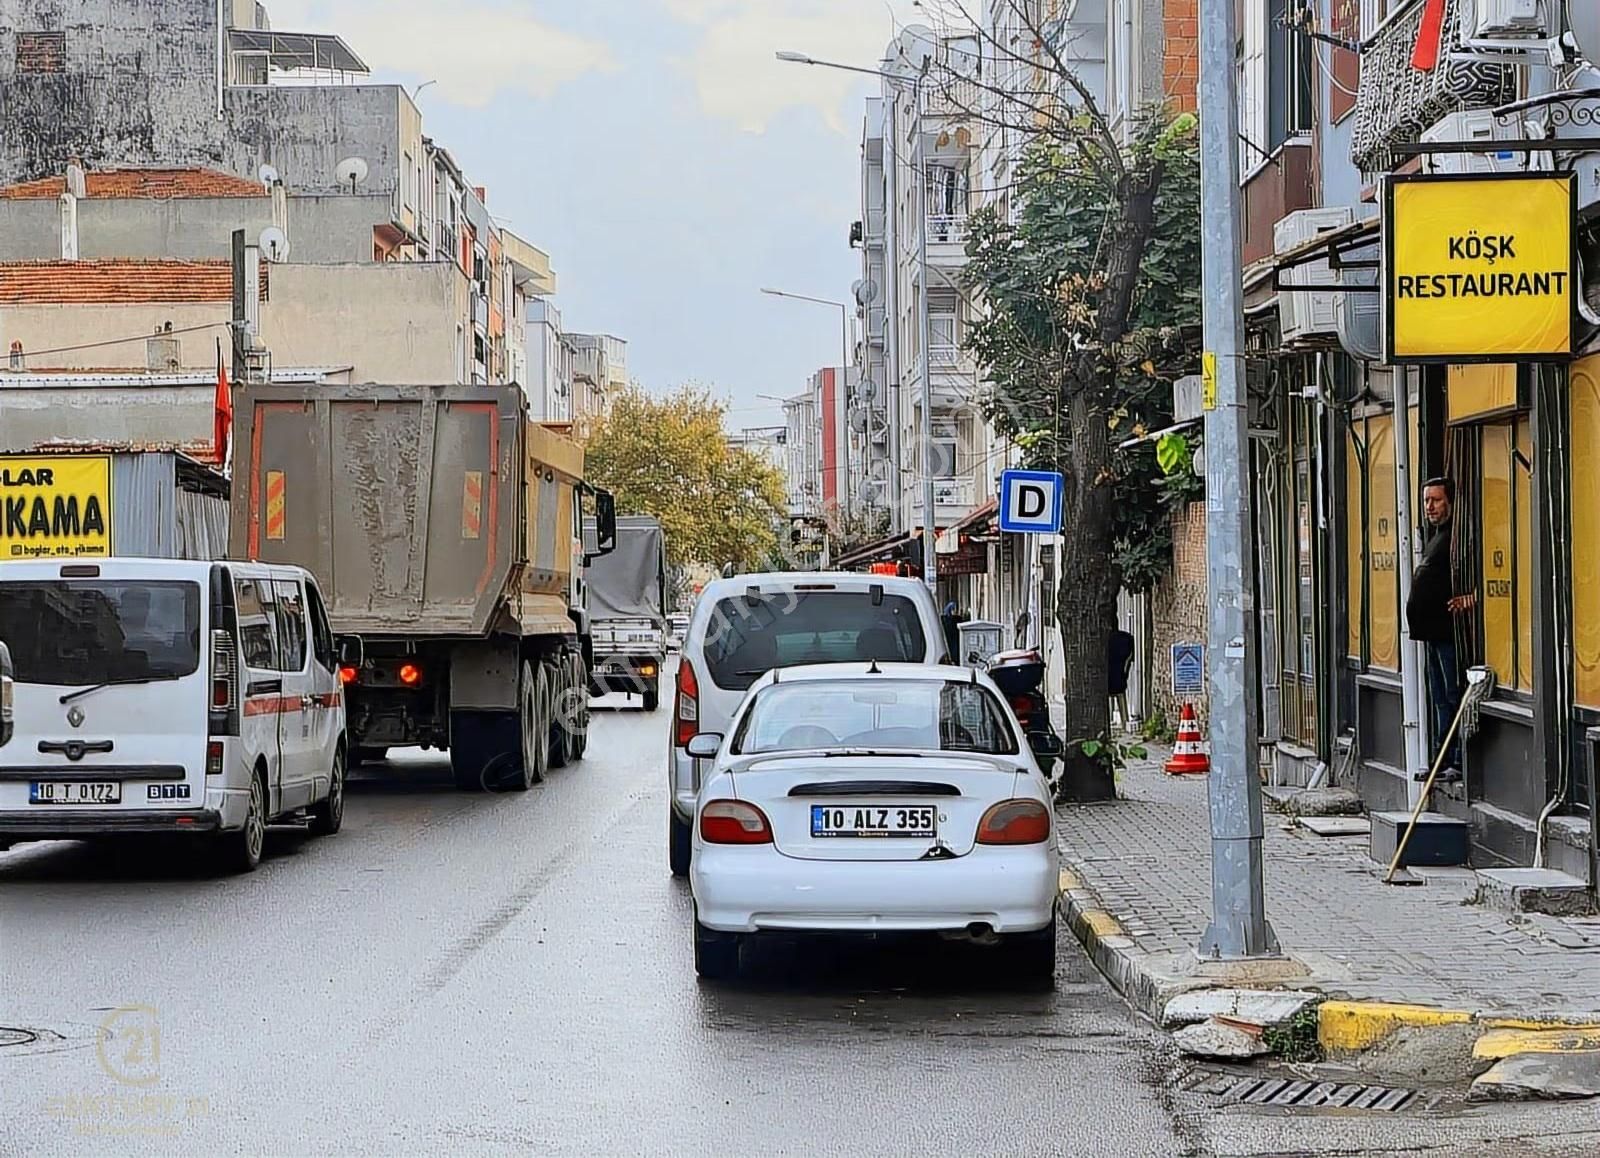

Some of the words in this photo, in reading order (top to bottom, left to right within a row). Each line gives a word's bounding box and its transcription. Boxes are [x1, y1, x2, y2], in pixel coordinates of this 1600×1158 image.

[1449, 230, 1516, 265] KÖŞK
[1398, 271, 1568, 298] RESTAURANT
[0, 468, 54, 487] LAR
[1018, 485, 1046, 518] D
[39, 784, 54, 799] 10
[63, 784, 72, 799] T
[148, 785, 191, 799] BTT
[823, 810, 844, 829] 10
[854, 810, 889, 829] ALZ
[896, 810, 931, 829] 355
